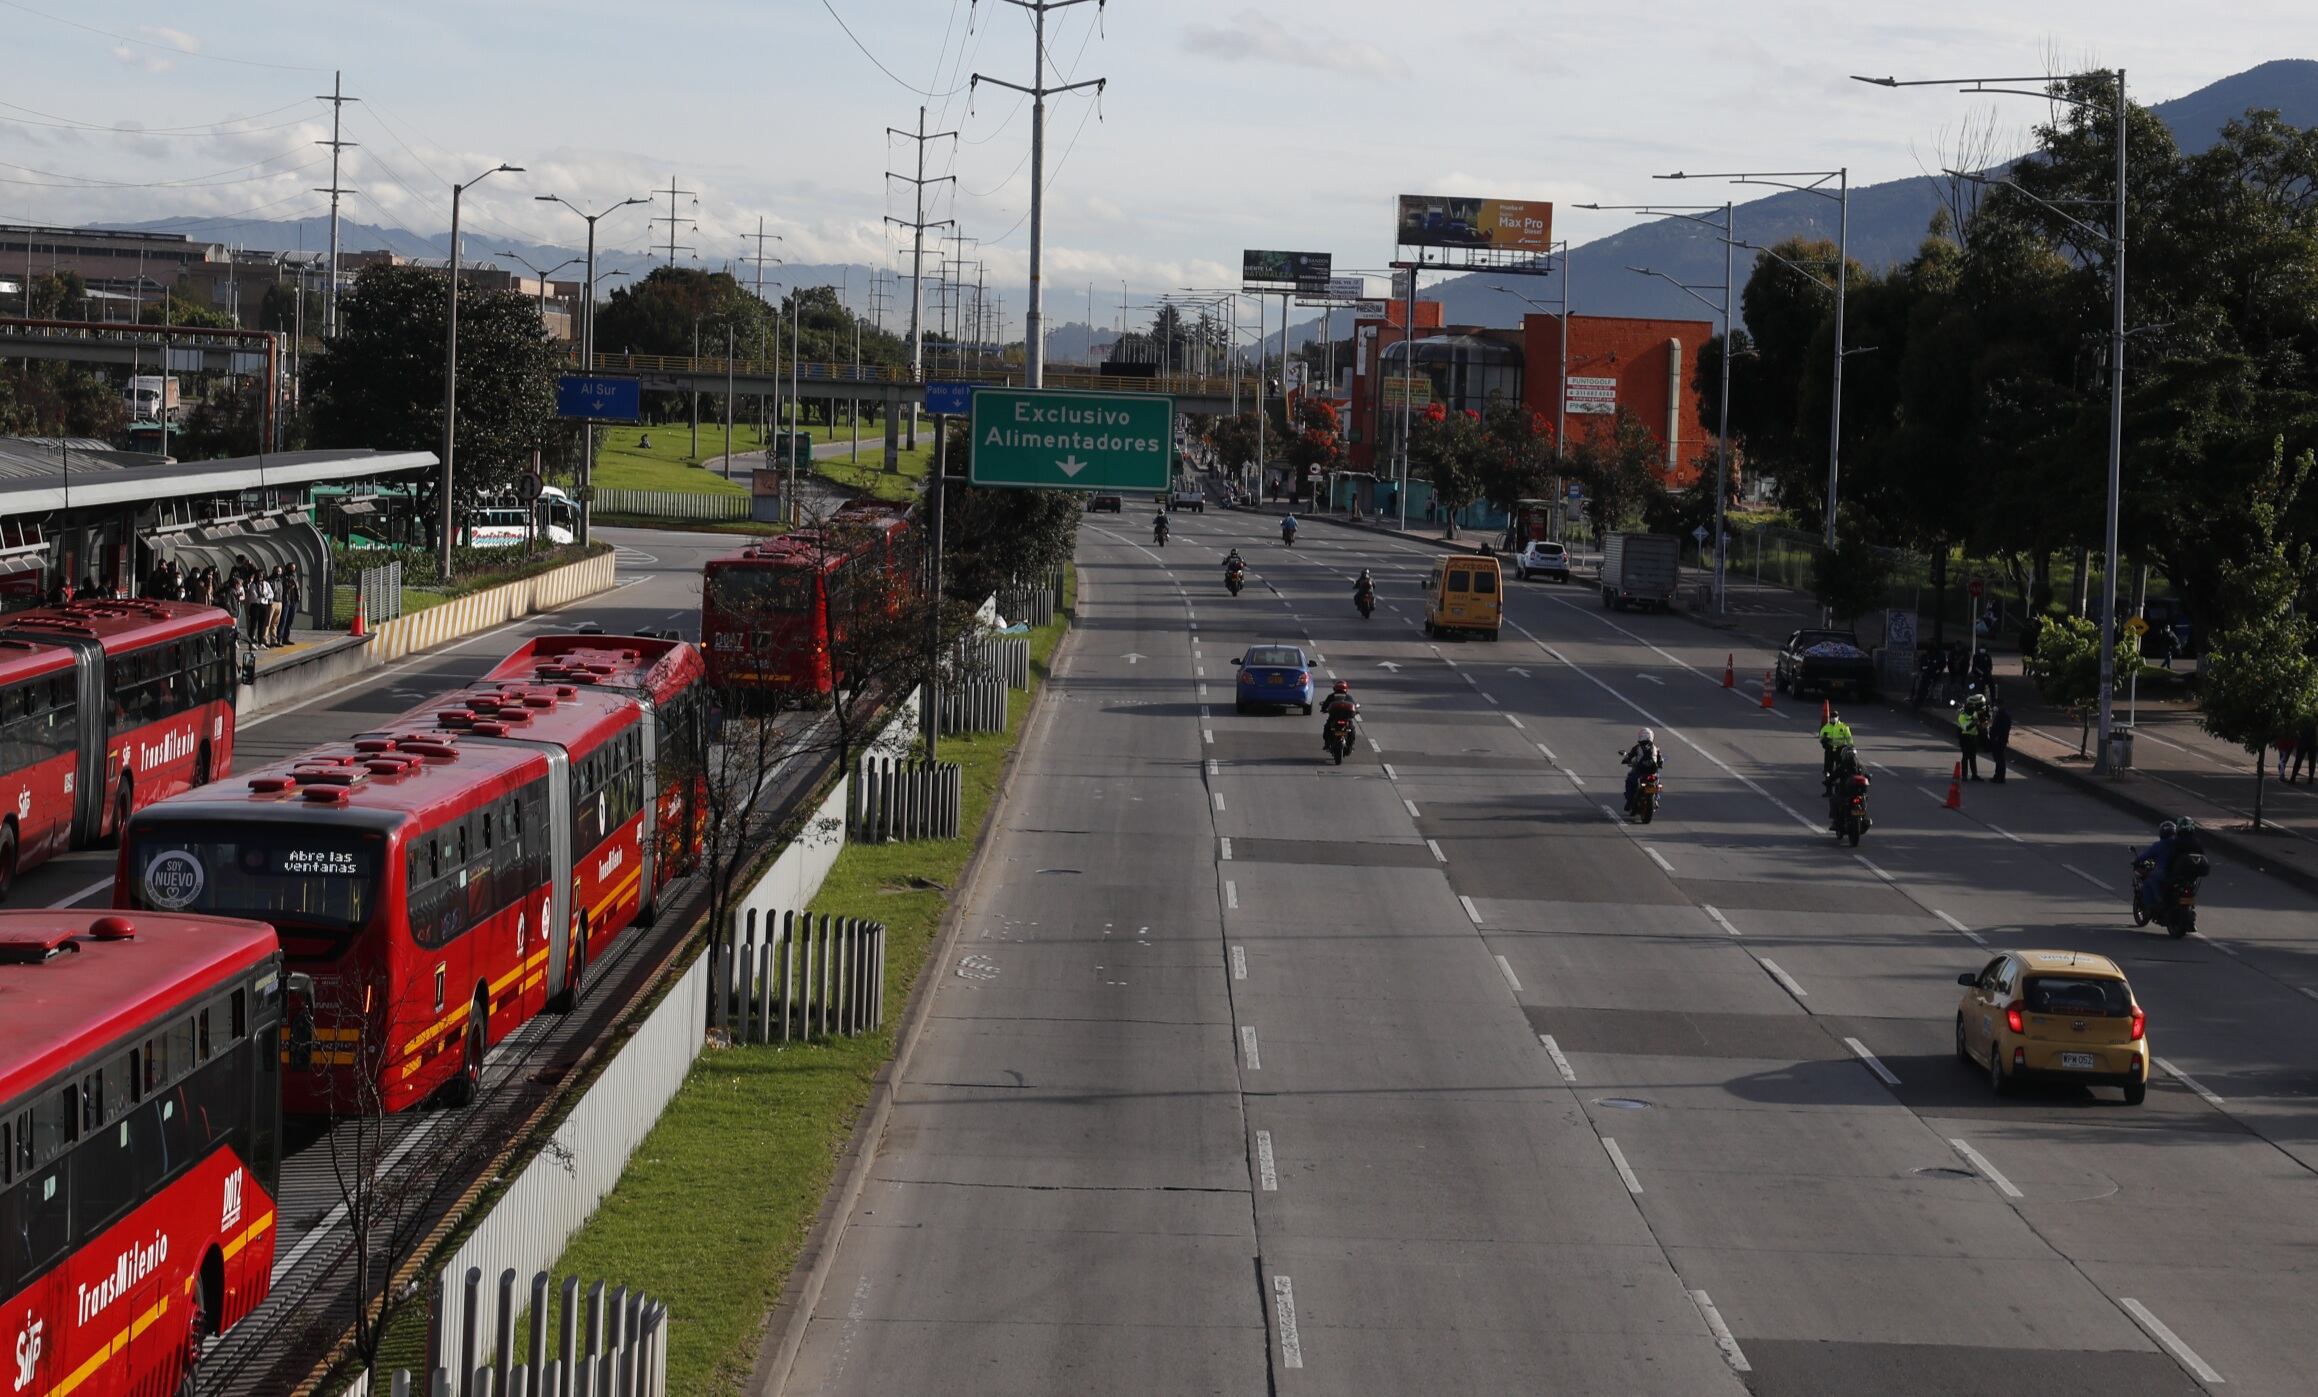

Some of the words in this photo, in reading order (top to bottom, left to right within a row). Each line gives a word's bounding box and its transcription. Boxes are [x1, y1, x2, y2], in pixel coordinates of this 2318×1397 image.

[1499, 217, 1521, 228] Max
[1524, 217, 1543, 229] Pro
[581, 383, 593, 395] Al
[596, 383, 617, 396] Sur
[927, 385, 948, 395] Patio
[952, 386, 966, 396] del
[1015, 401, 1130, 425] Exclusivo
[984, 426, 1160, 452] Alimentadores
[140, 723, 195, 772] TransMilenio
[289, 850, 325, 862] Abre
[329, 851, 353, 863] las
[166, 860, 183, 871] SOY
[284, 862, 357, 873] ventanas
[598, 844, 623, 884] TransMilenio
[155, 871, 194, 887] NUEVO
[77, 1228, 168, 1328] TransMilenio
